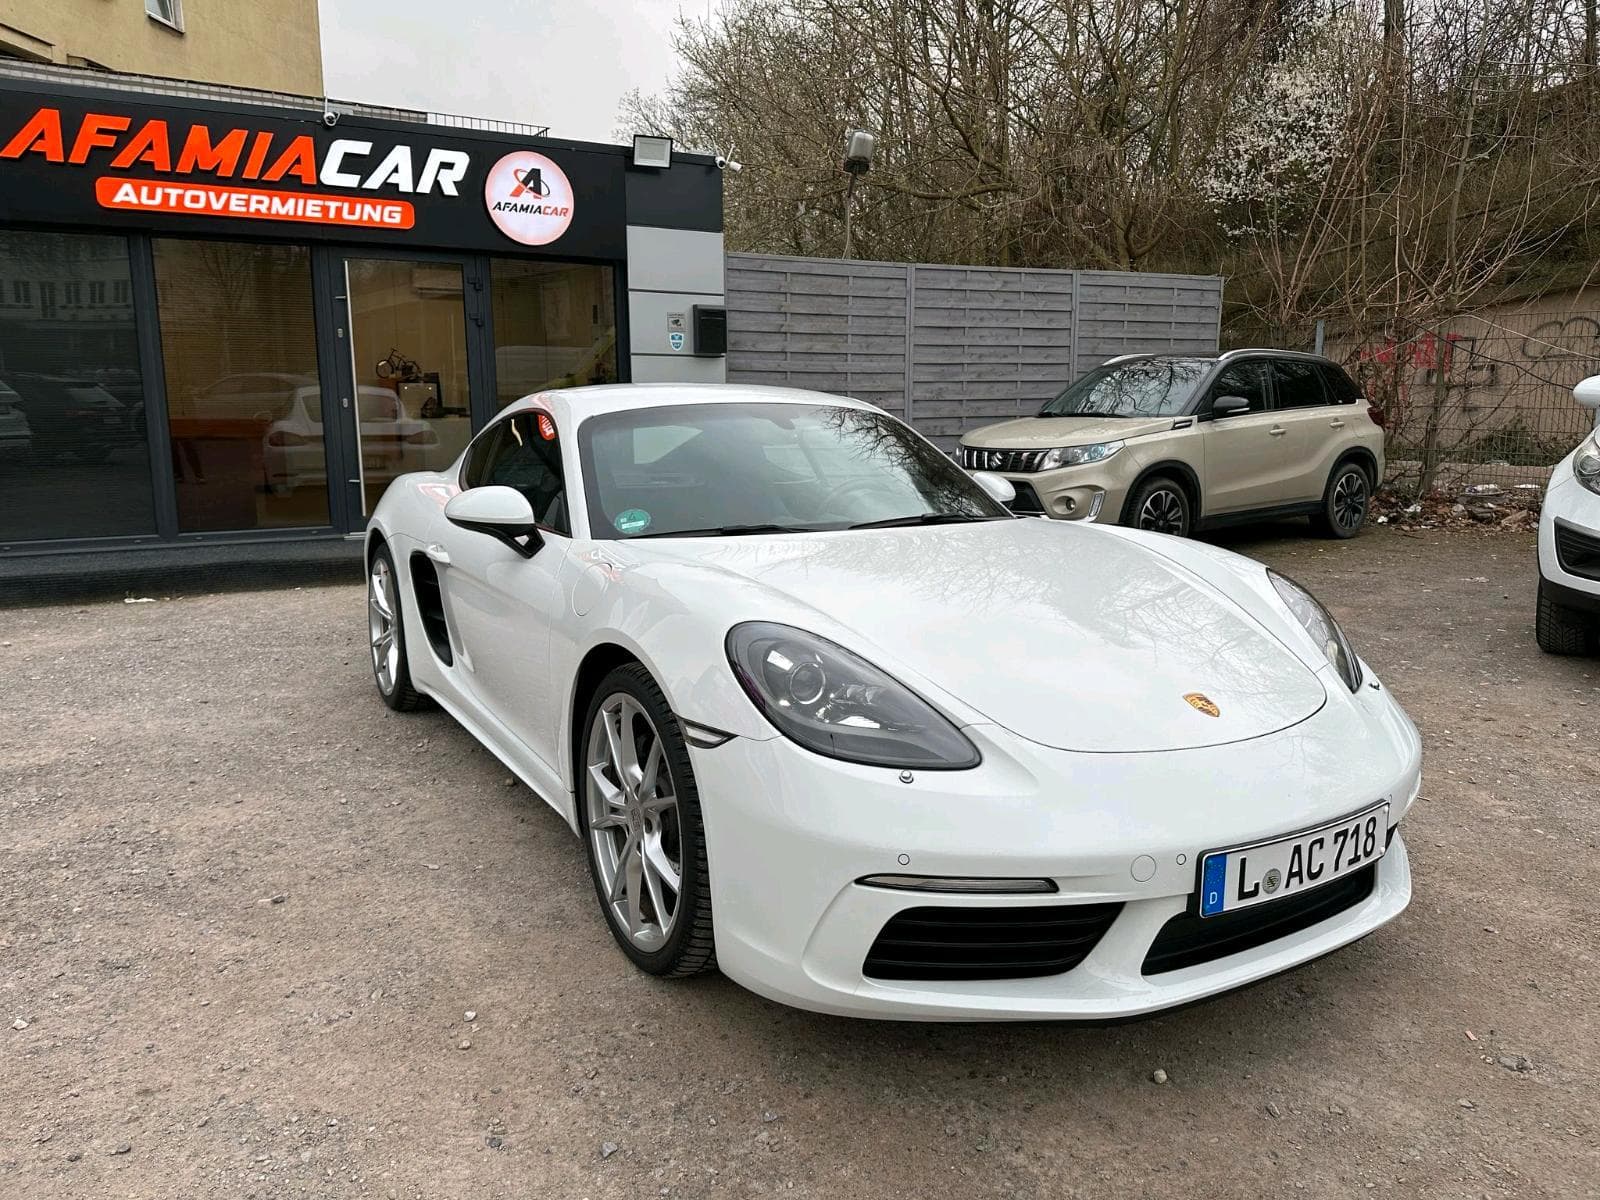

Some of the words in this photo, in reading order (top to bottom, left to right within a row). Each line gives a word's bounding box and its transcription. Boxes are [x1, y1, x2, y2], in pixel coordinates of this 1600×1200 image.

[0, 108, 470, 197] AFAMIACAR
[112, 182, 402, 223] AUTOVERMIETUNG
[492, 201, 569, 217] AFAMIACAR
[1238, 856, 1260, 901] L
[1284, 836, 1325, 889] AC
[1333, 816, 1378, 872] 718
[1209, 891, 1218, 905] D
